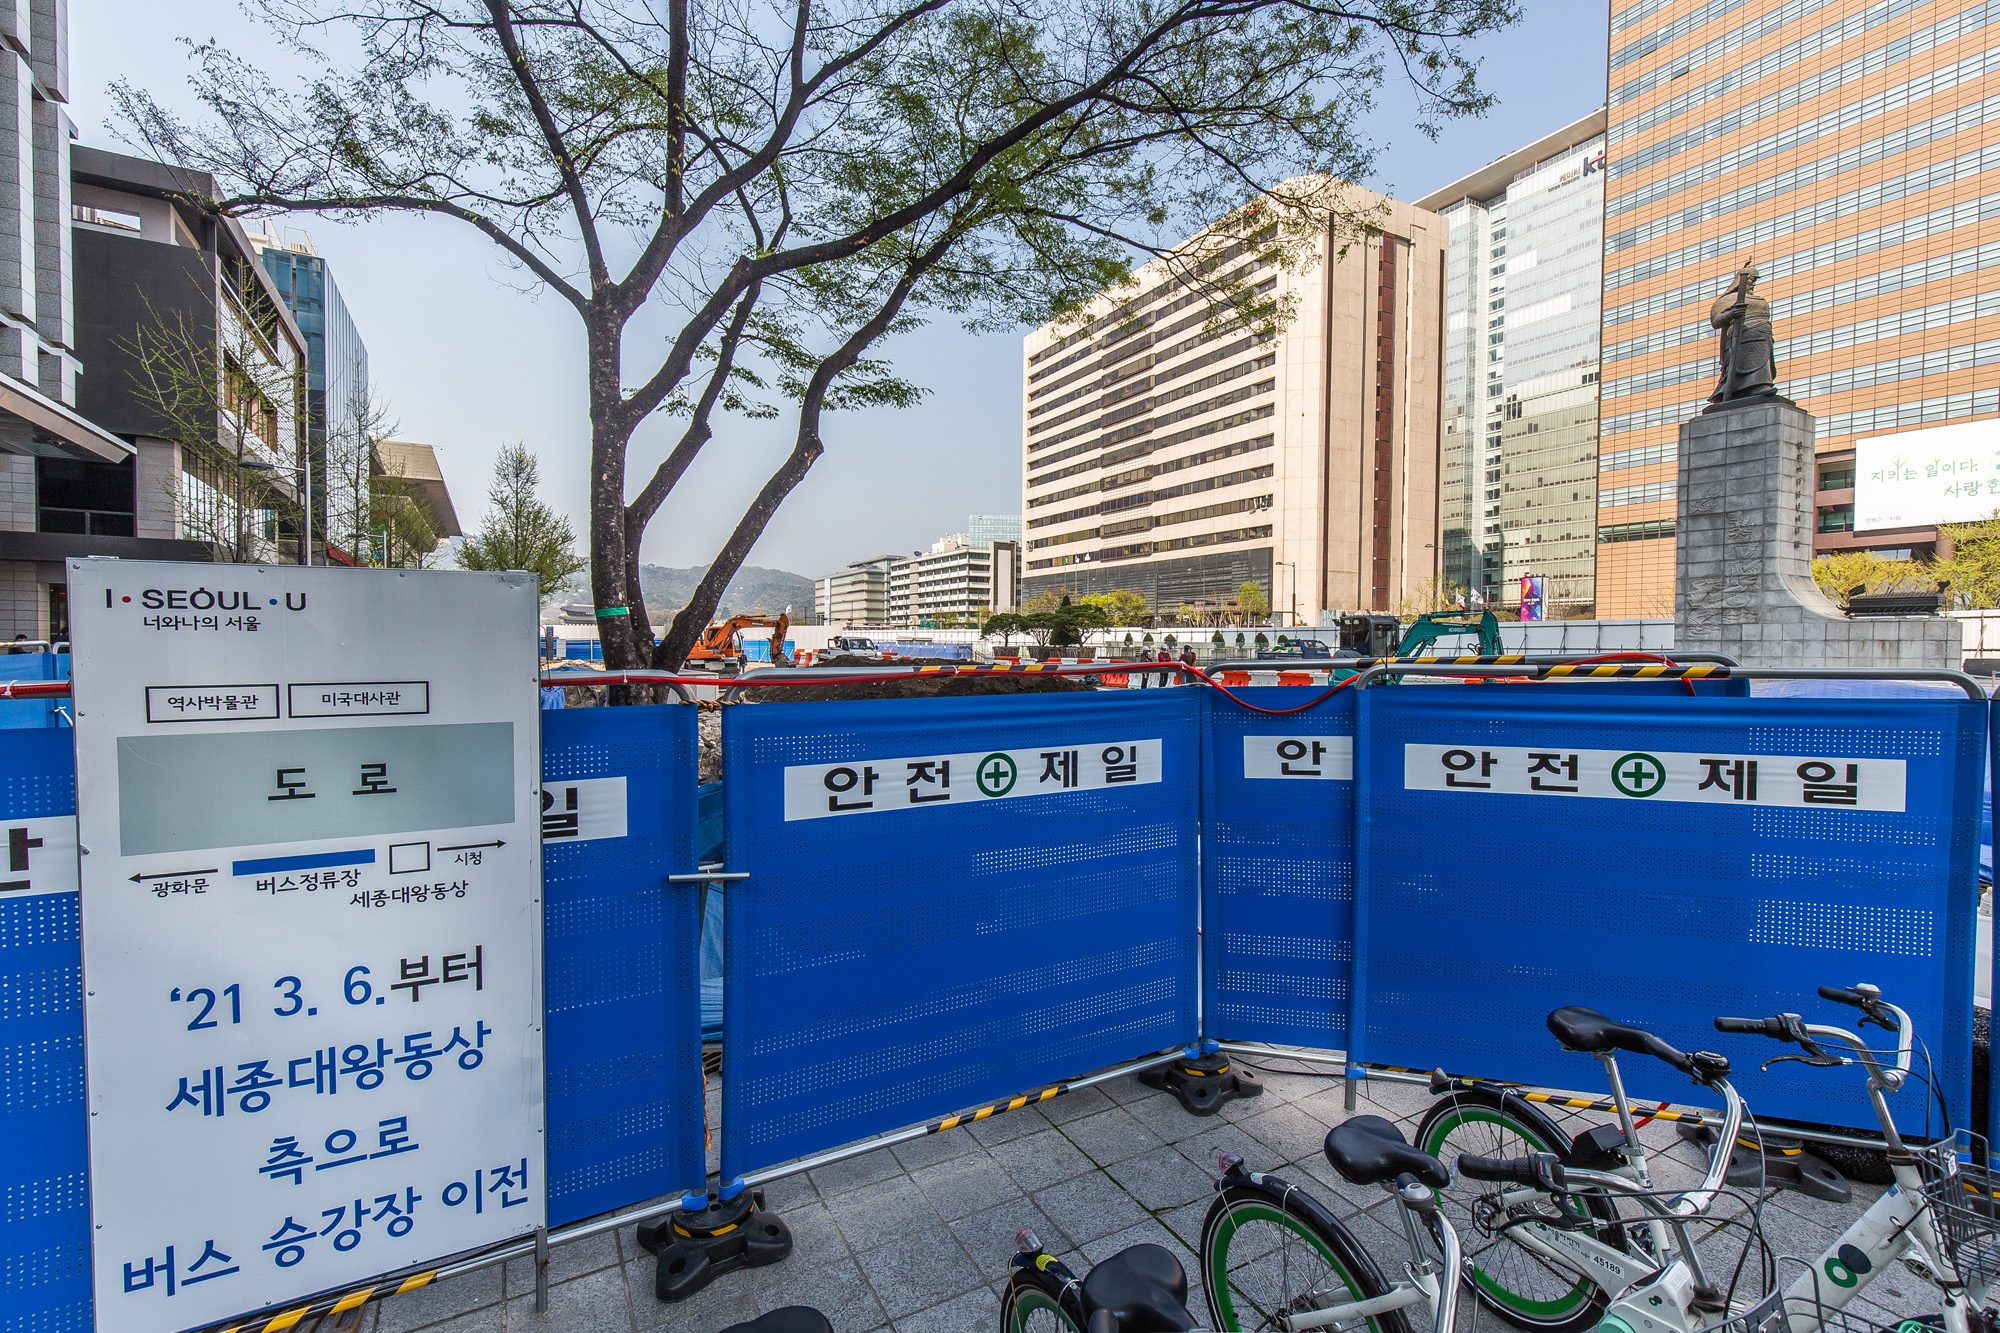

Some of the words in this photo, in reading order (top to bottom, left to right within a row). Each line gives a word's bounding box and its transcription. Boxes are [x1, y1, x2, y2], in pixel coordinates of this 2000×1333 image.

[1871, 457, 1918, 483] 지키는
[1925, 457, 1979, 478] 일이다.
[143, 616, 218, 631] 너와나의
[225, 615, 261, 632] 서울
[167, 694, 259, 712] 역사박물관
[321, 690, 402, 707] 미국대사관
[1276, 739, 1327, 776] 안
[454, 851, 482, 865] 시청
[151, 877, 210, 898] 광화문
[256, 868, 362, 896] 버스정류장
[349, 880, 469, 908] 세종대왕동상
[273, 975, 318, 1017] 3.
[165, 1020, 492, 1117] 세종대왕동상
[257, 1115, 419, 1186] 측으로
[123, 1239, 240, 1297] 버스
[261, 1185, 423, 1268] 승강장
[441, 1157, 529, 1214] 이전
[1593, 1255, 1621, 1275] 45189
